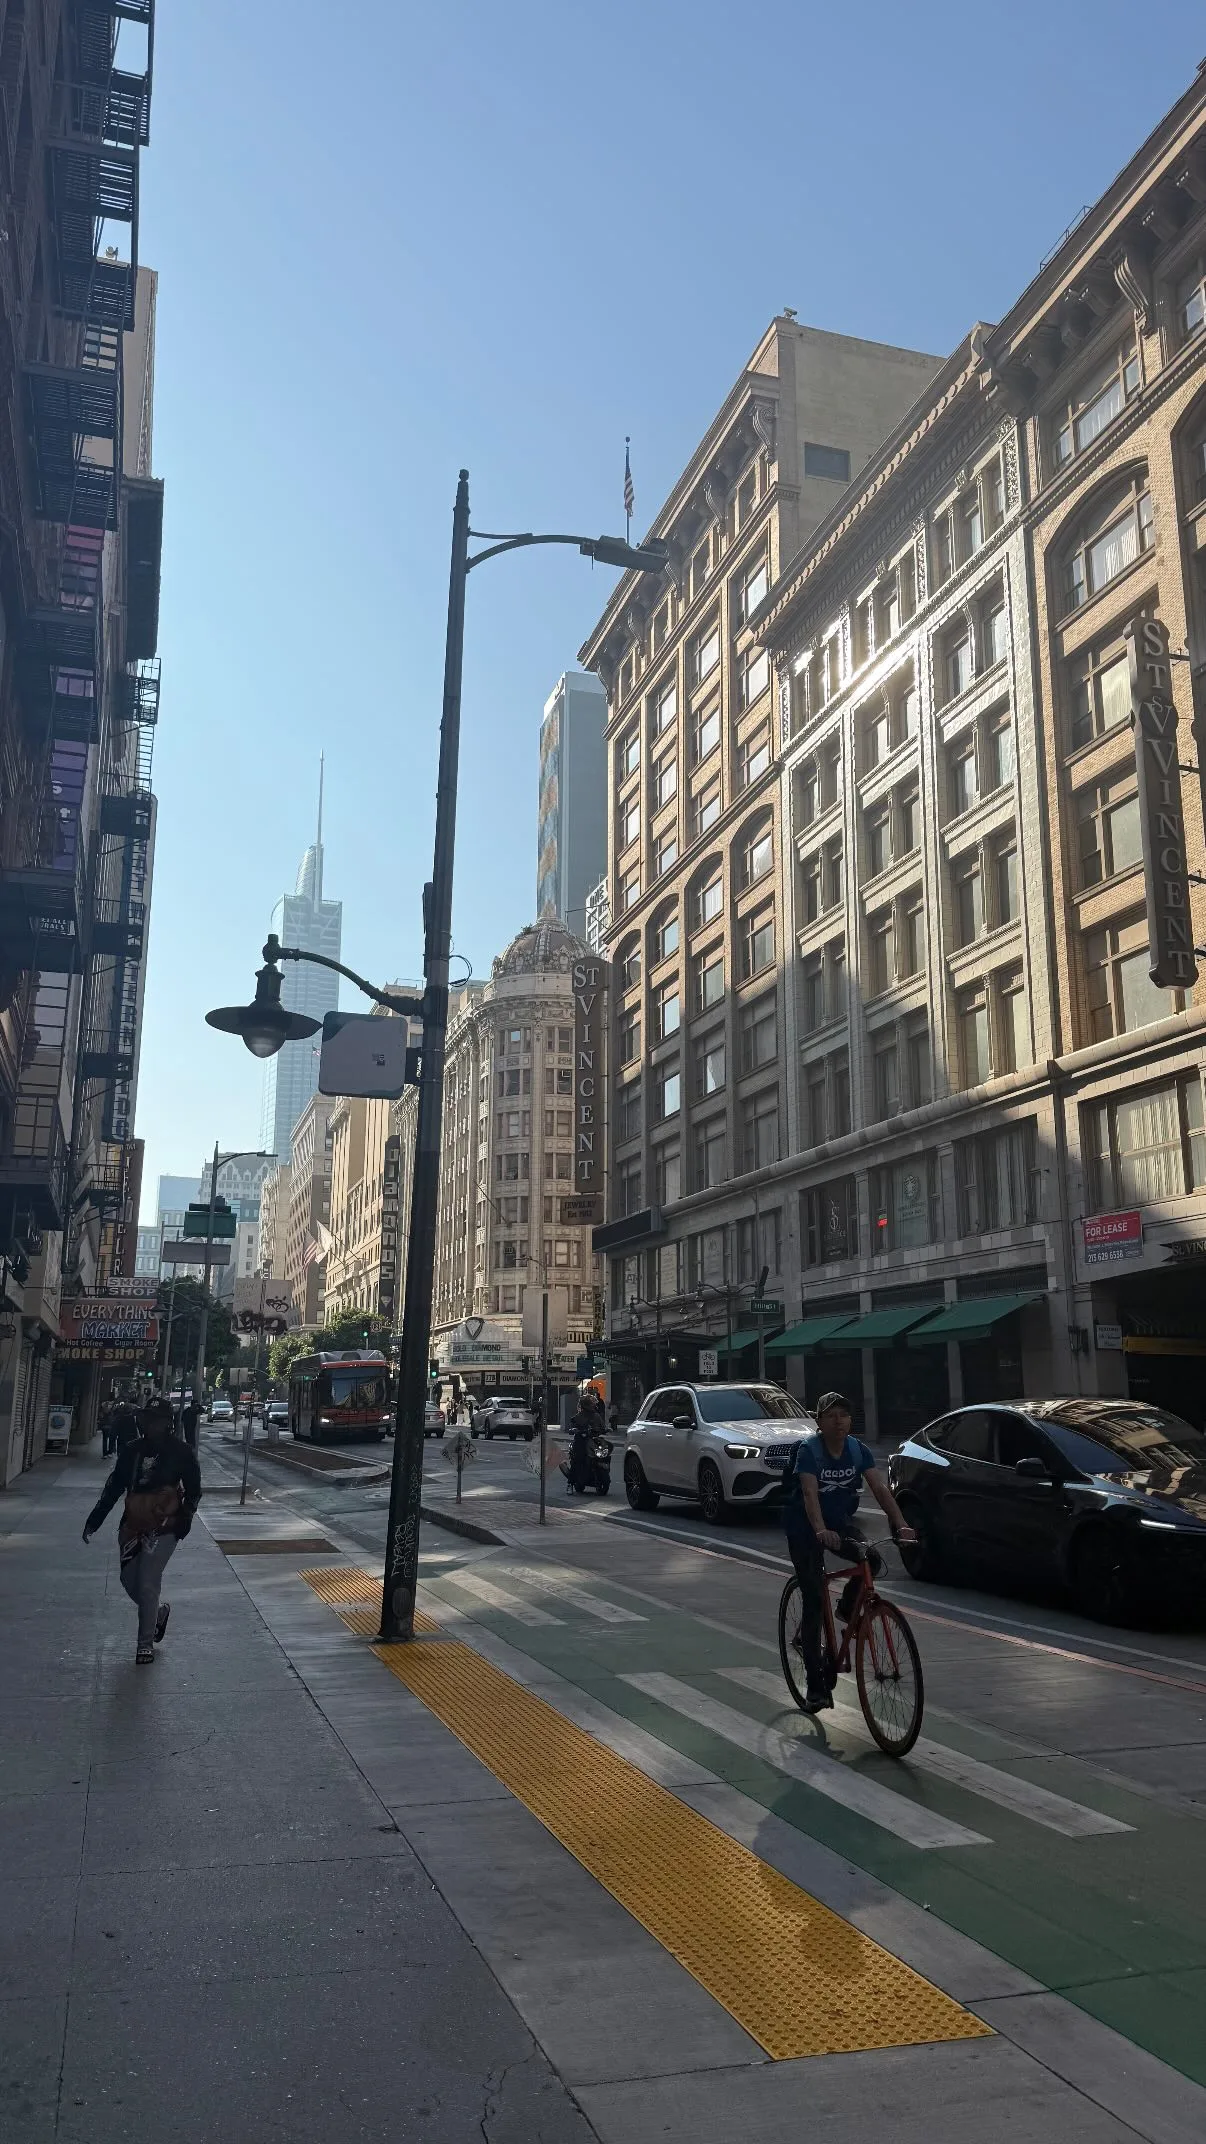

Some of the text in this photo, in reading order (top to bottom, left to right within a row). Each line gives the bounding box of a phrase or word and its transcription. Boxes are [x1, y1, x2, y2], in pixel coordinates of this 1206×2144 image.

[1142, 622, 1191, 979] ST VINCENT
[574, 965, 600, 1180] ST VINCENT
[1086, 1226, 1101, 1237] FOR
[1103, 1222, 1128, 1235] LEASE
[1098, 1252, 1108, 1261] 629
[108, 1278, 159, 1287] SMOKE
[108, 1288, 156, 1296] SHOP
[594, 1293, 602, 1339] PARKING
[81, 1321, 151, 1339] MARKET
[81, 1339, 104, 1347] Coffee
[114, 1339, 133, 1347] Cigar
[134, 1339, 154, 1347] Room
[57, 1347, 144, 1360] MOKE SHOP
